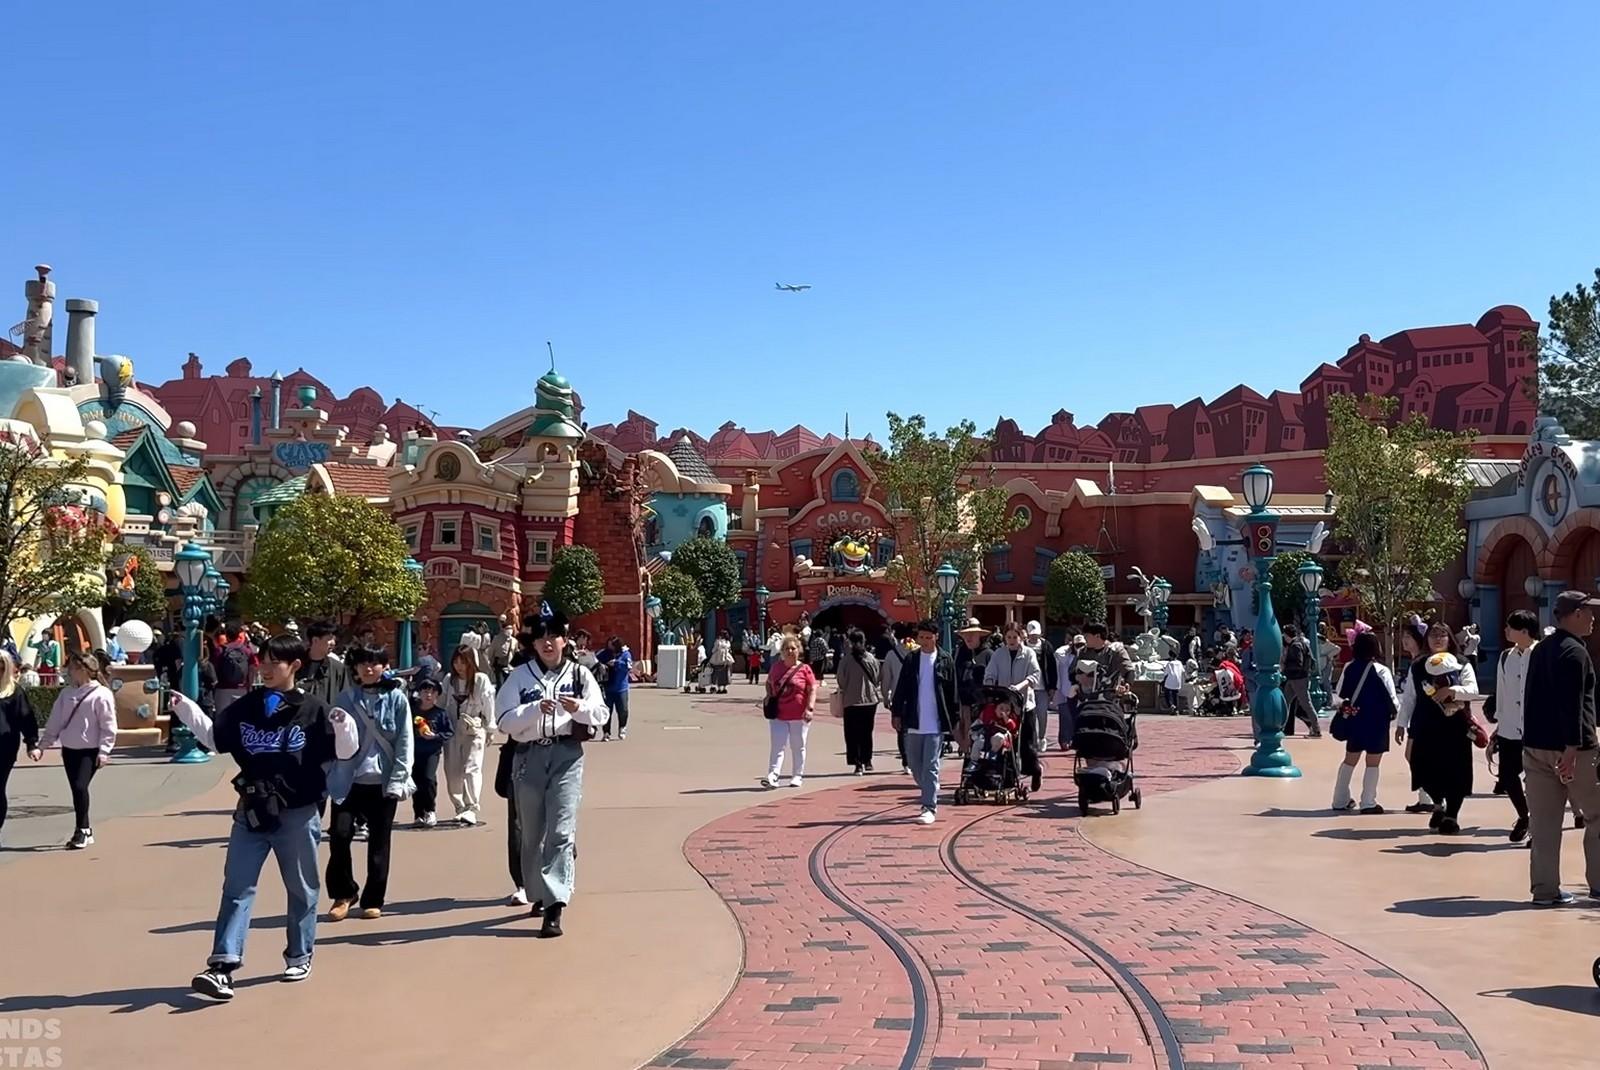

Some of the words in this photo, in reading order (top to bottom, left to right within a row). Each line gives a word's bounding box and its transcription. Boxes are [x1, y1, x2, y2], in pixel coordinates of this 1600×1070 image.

[1517, 442, 1544, 489] TROLLEY
[1550, 445, 1578, 481] BARN
[816, 510, 849, 527] CAB
[240, 722, 306, 753] Forcile
